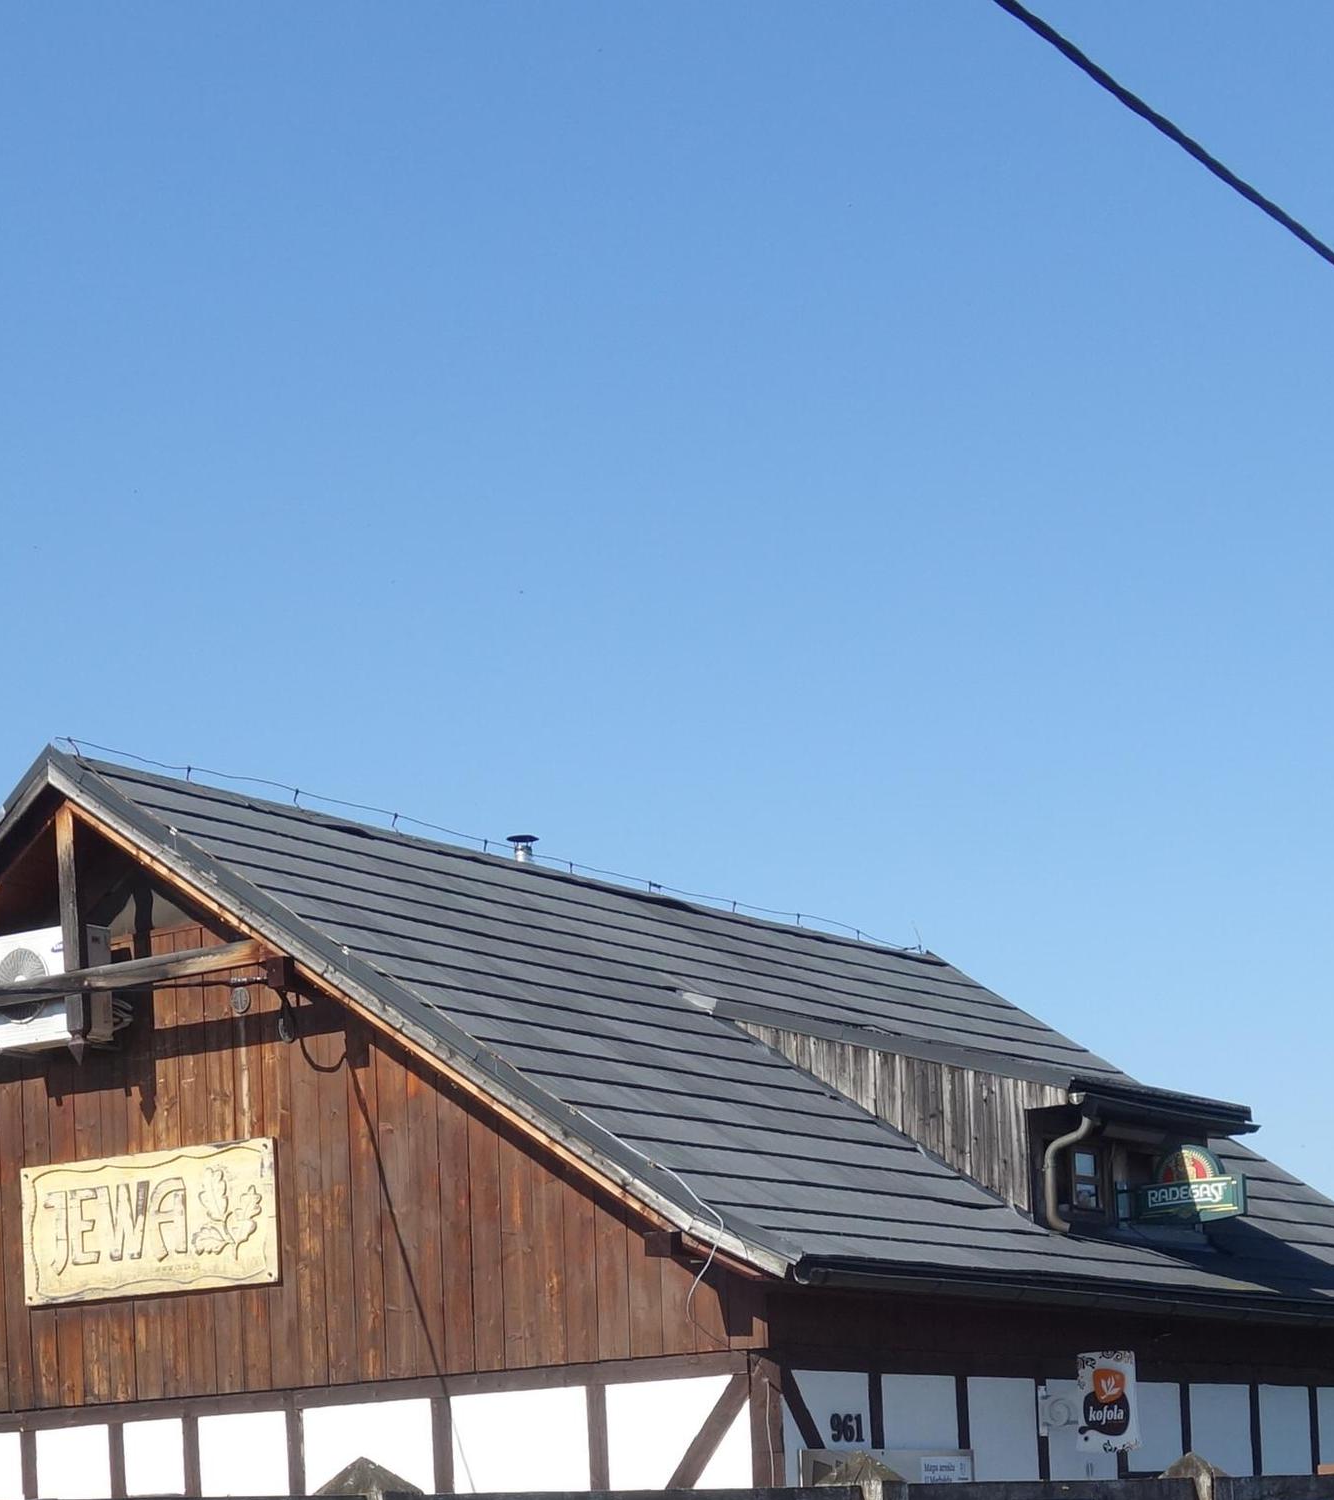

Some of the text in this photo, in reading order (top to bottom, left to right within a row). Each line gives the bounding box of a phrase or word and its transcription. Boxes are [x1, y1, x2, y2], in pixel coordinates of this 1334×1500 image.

[1148, 1182, 1227, 1208] RADEGAST
[43, 1177, 188, 1276] JEWA
[830, 1413, 865, 1443] 961
[1089, 1405, 1125, 1425] kofola
